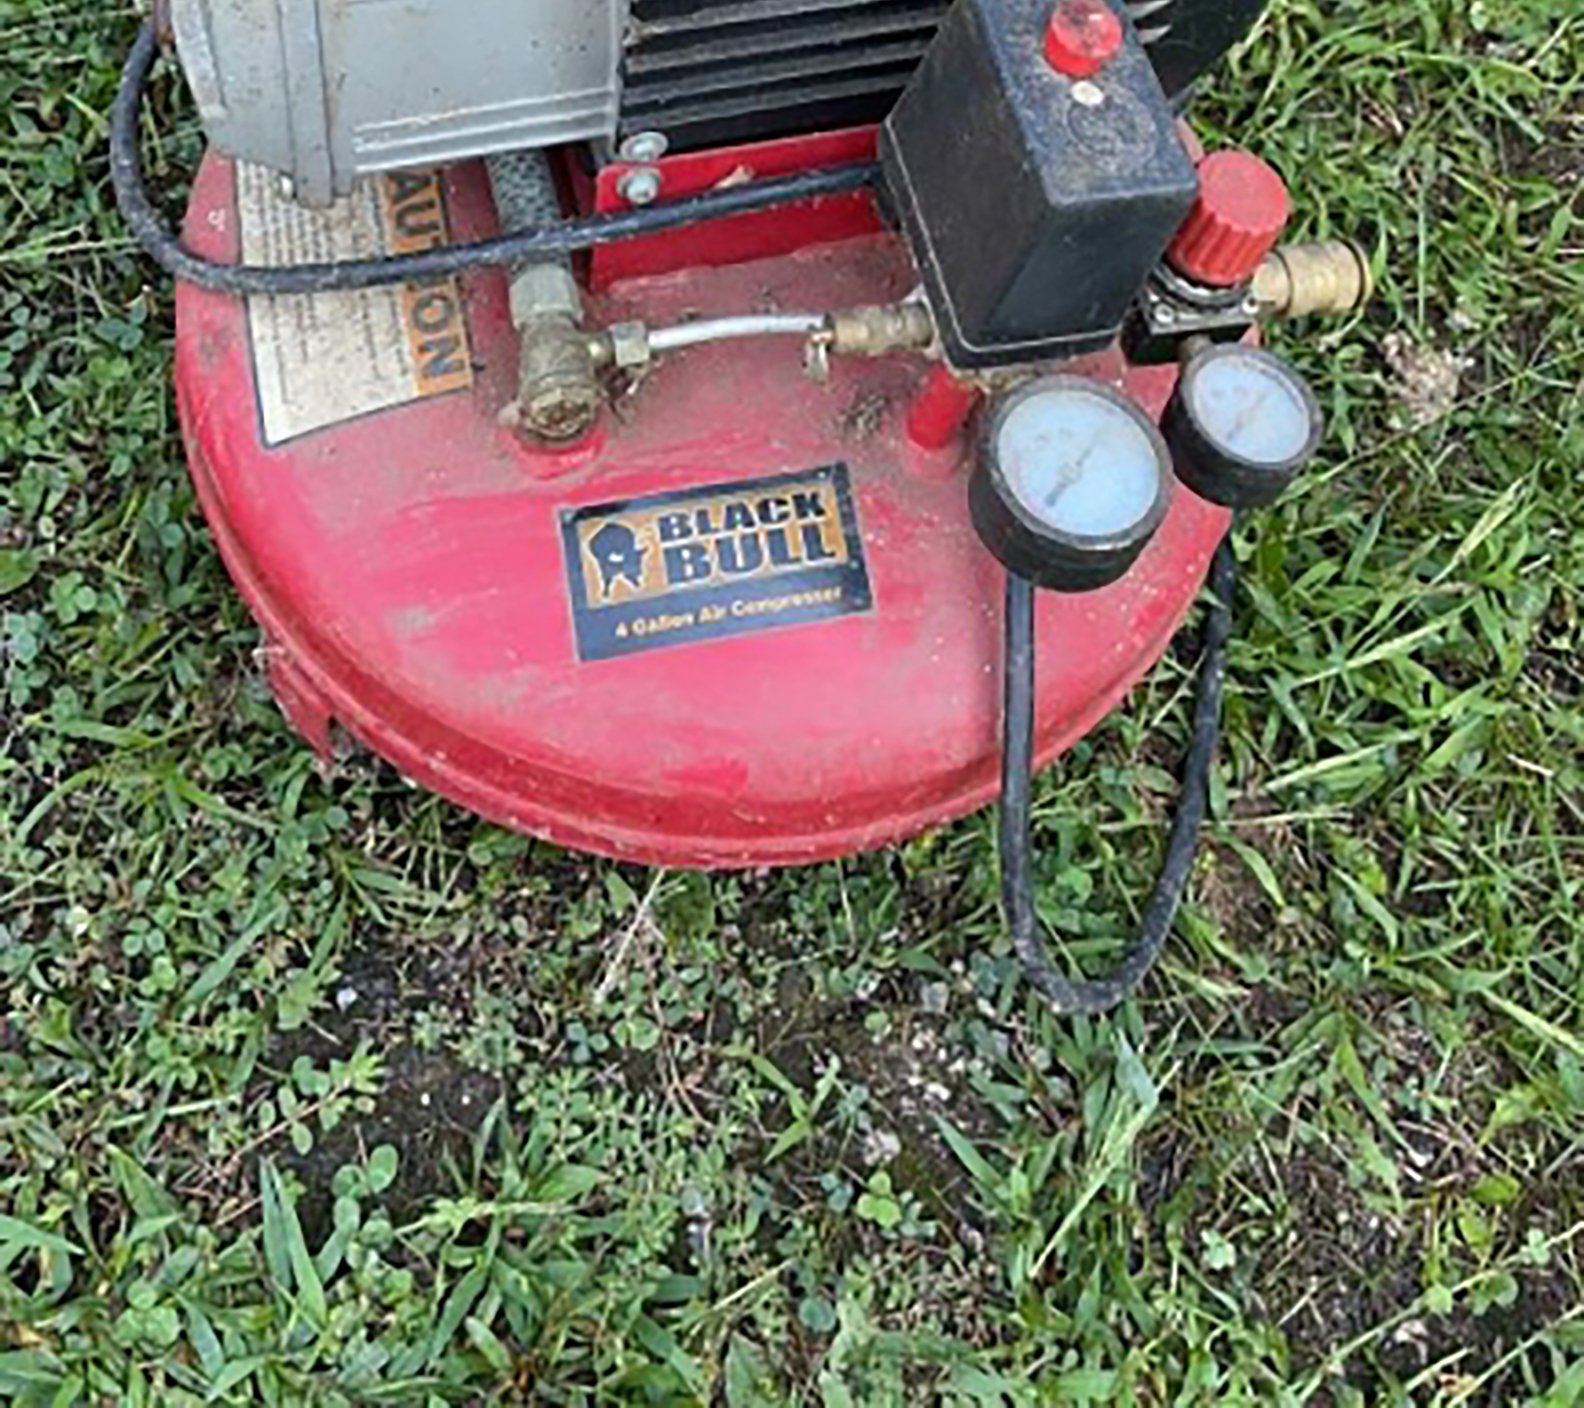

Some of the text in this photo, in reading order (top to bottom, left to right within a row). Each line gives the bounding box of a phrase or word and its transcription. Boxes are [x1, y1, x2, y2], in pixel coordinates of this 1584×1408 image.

[389, 169, 465, 376] AUON
[658, 493, 826, 540] BLACK
[663, 523, 836, 583] BULL
[615, 621, 629, 638] 4
[632, 614, 694, 635] Gallon
[699, 605, 727, 623] Air
